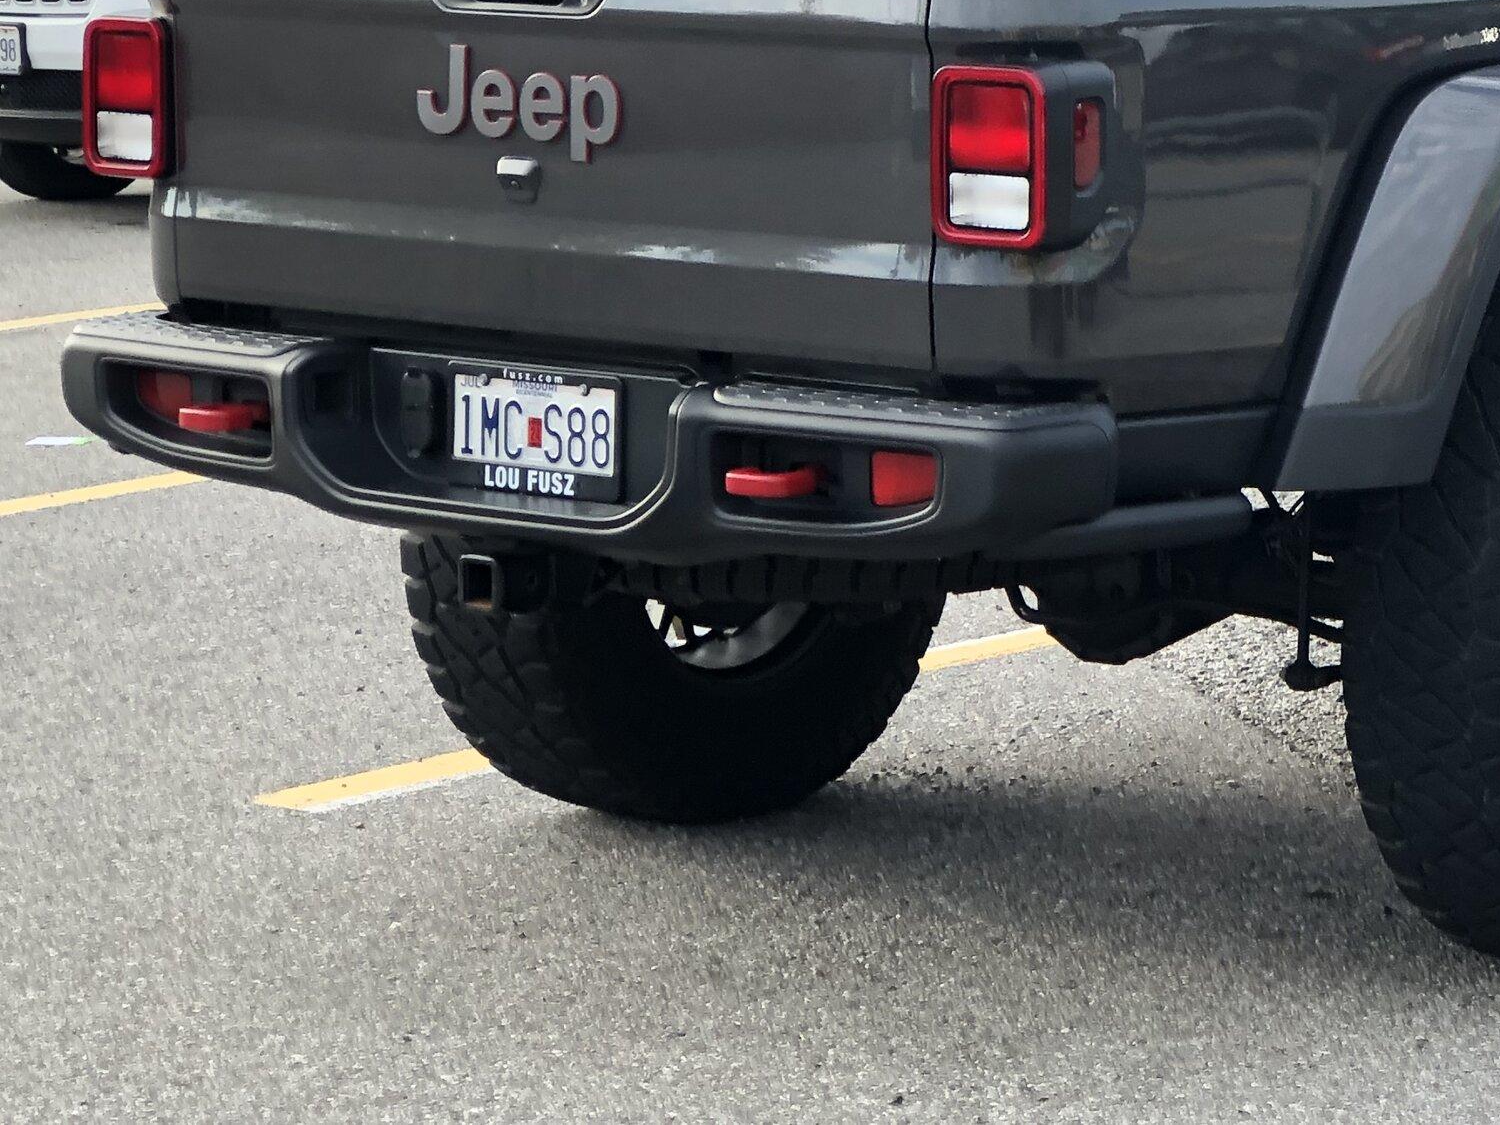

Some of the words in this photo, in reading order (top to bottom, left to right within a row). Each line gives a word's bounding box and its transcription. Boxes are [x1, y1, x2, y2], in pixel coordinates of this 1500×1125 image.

[417, 43, 623, 163] Jeep
[502, 368, 564, 384] fusz.com
[512, 380, 558, 392] MISSOURI
[460, 393, 523, 460] 1MC
[544, 403, 610, 469] S88
[484, 464, 520, 490] LOU
[526, 469, 575, 496] FUSZ
